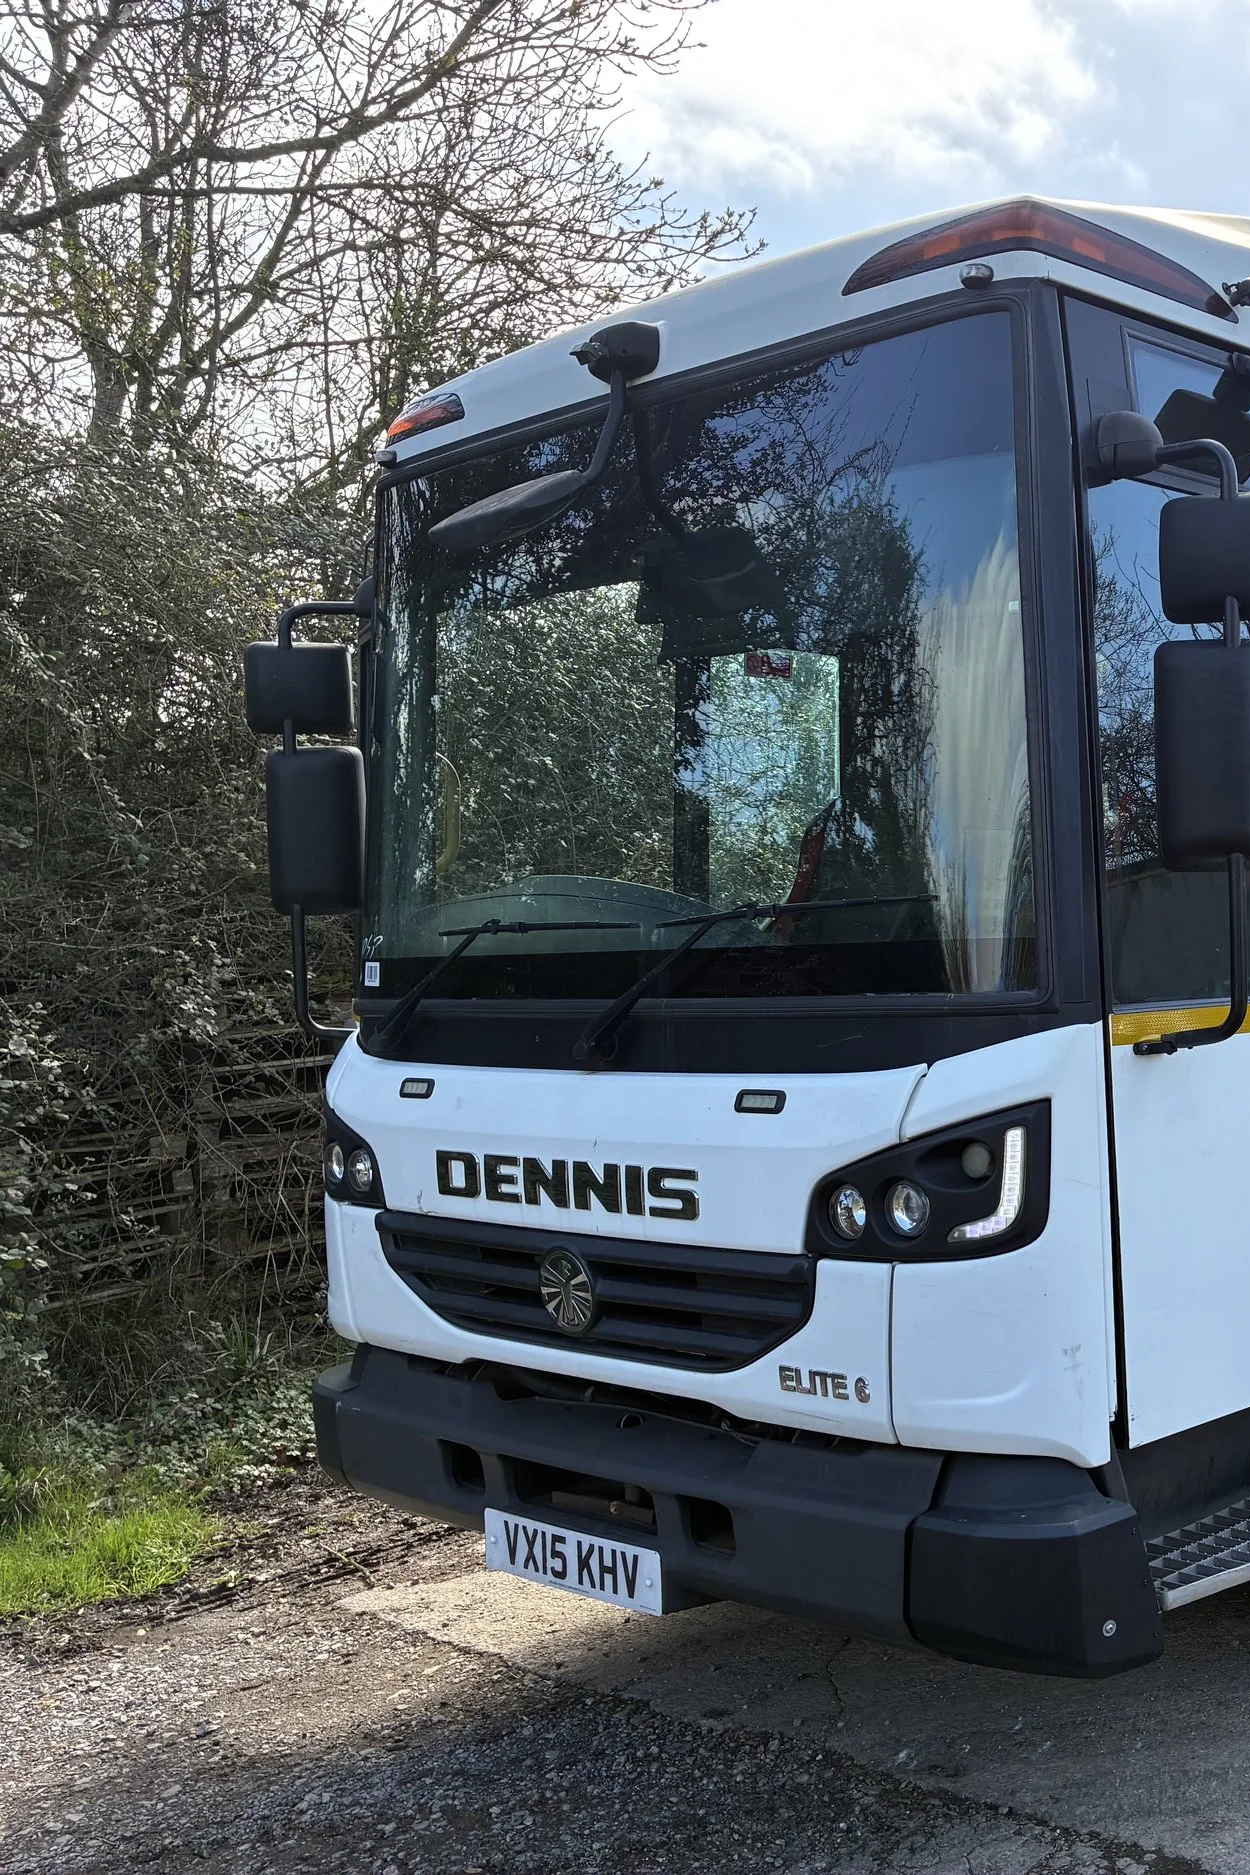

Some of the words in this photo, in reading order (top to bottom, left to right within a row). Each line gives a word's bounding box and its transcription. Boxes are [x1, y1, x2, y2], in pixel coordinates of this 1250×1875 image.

[436, 1150, 700, 1221] DENNIS
[779, 1364, 849, 1401] ELITE
[854, 1376, 871, 1404] 6
[503, 1519, 568, 1581] VX15
[577, 1540, 639, 1600] KHV
